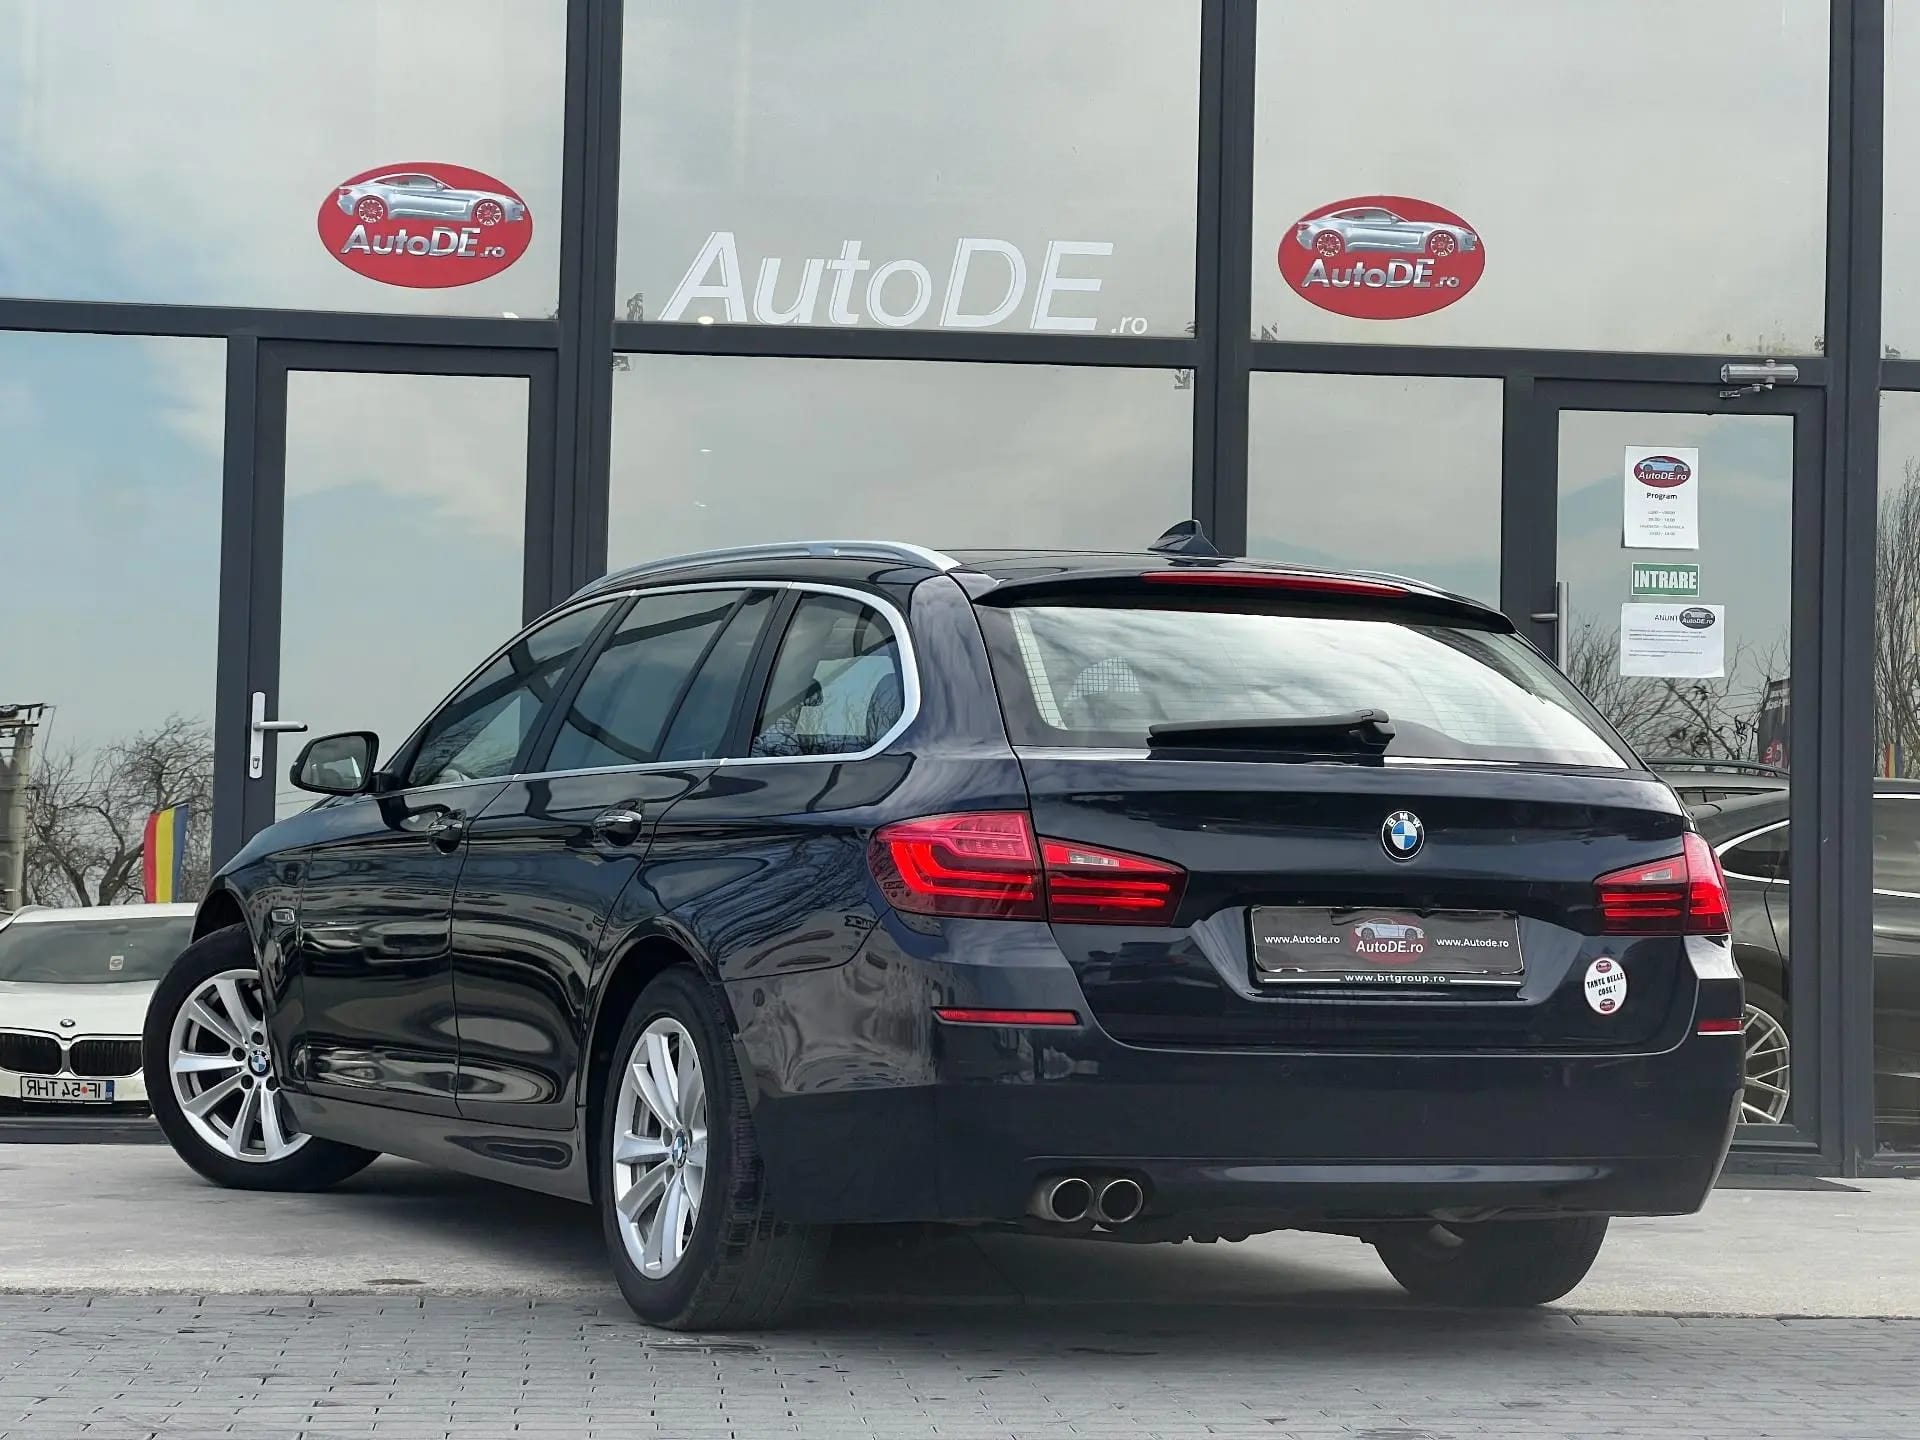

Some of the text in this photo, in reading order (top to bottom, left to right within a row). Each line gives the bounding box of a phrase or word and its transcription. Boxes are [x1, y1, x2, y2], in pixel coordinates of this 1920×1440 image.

[1638, 471, 1687, 481] AutoDE.ro
[1646, 492, 1678, 501] Program
[1634, 569, 1697, 590] INTRARE
[1264, 934, 1341, 945] www.Autode.ro
[1436, 937, 1510, 948] www.Autode.ro
[1355, 940, 1424, 954] AutoDE.ro
[1344, 973, 1446, 984] www.brtgroup.ro
[1586, 972, 1624, 989] TANTE BELLE
